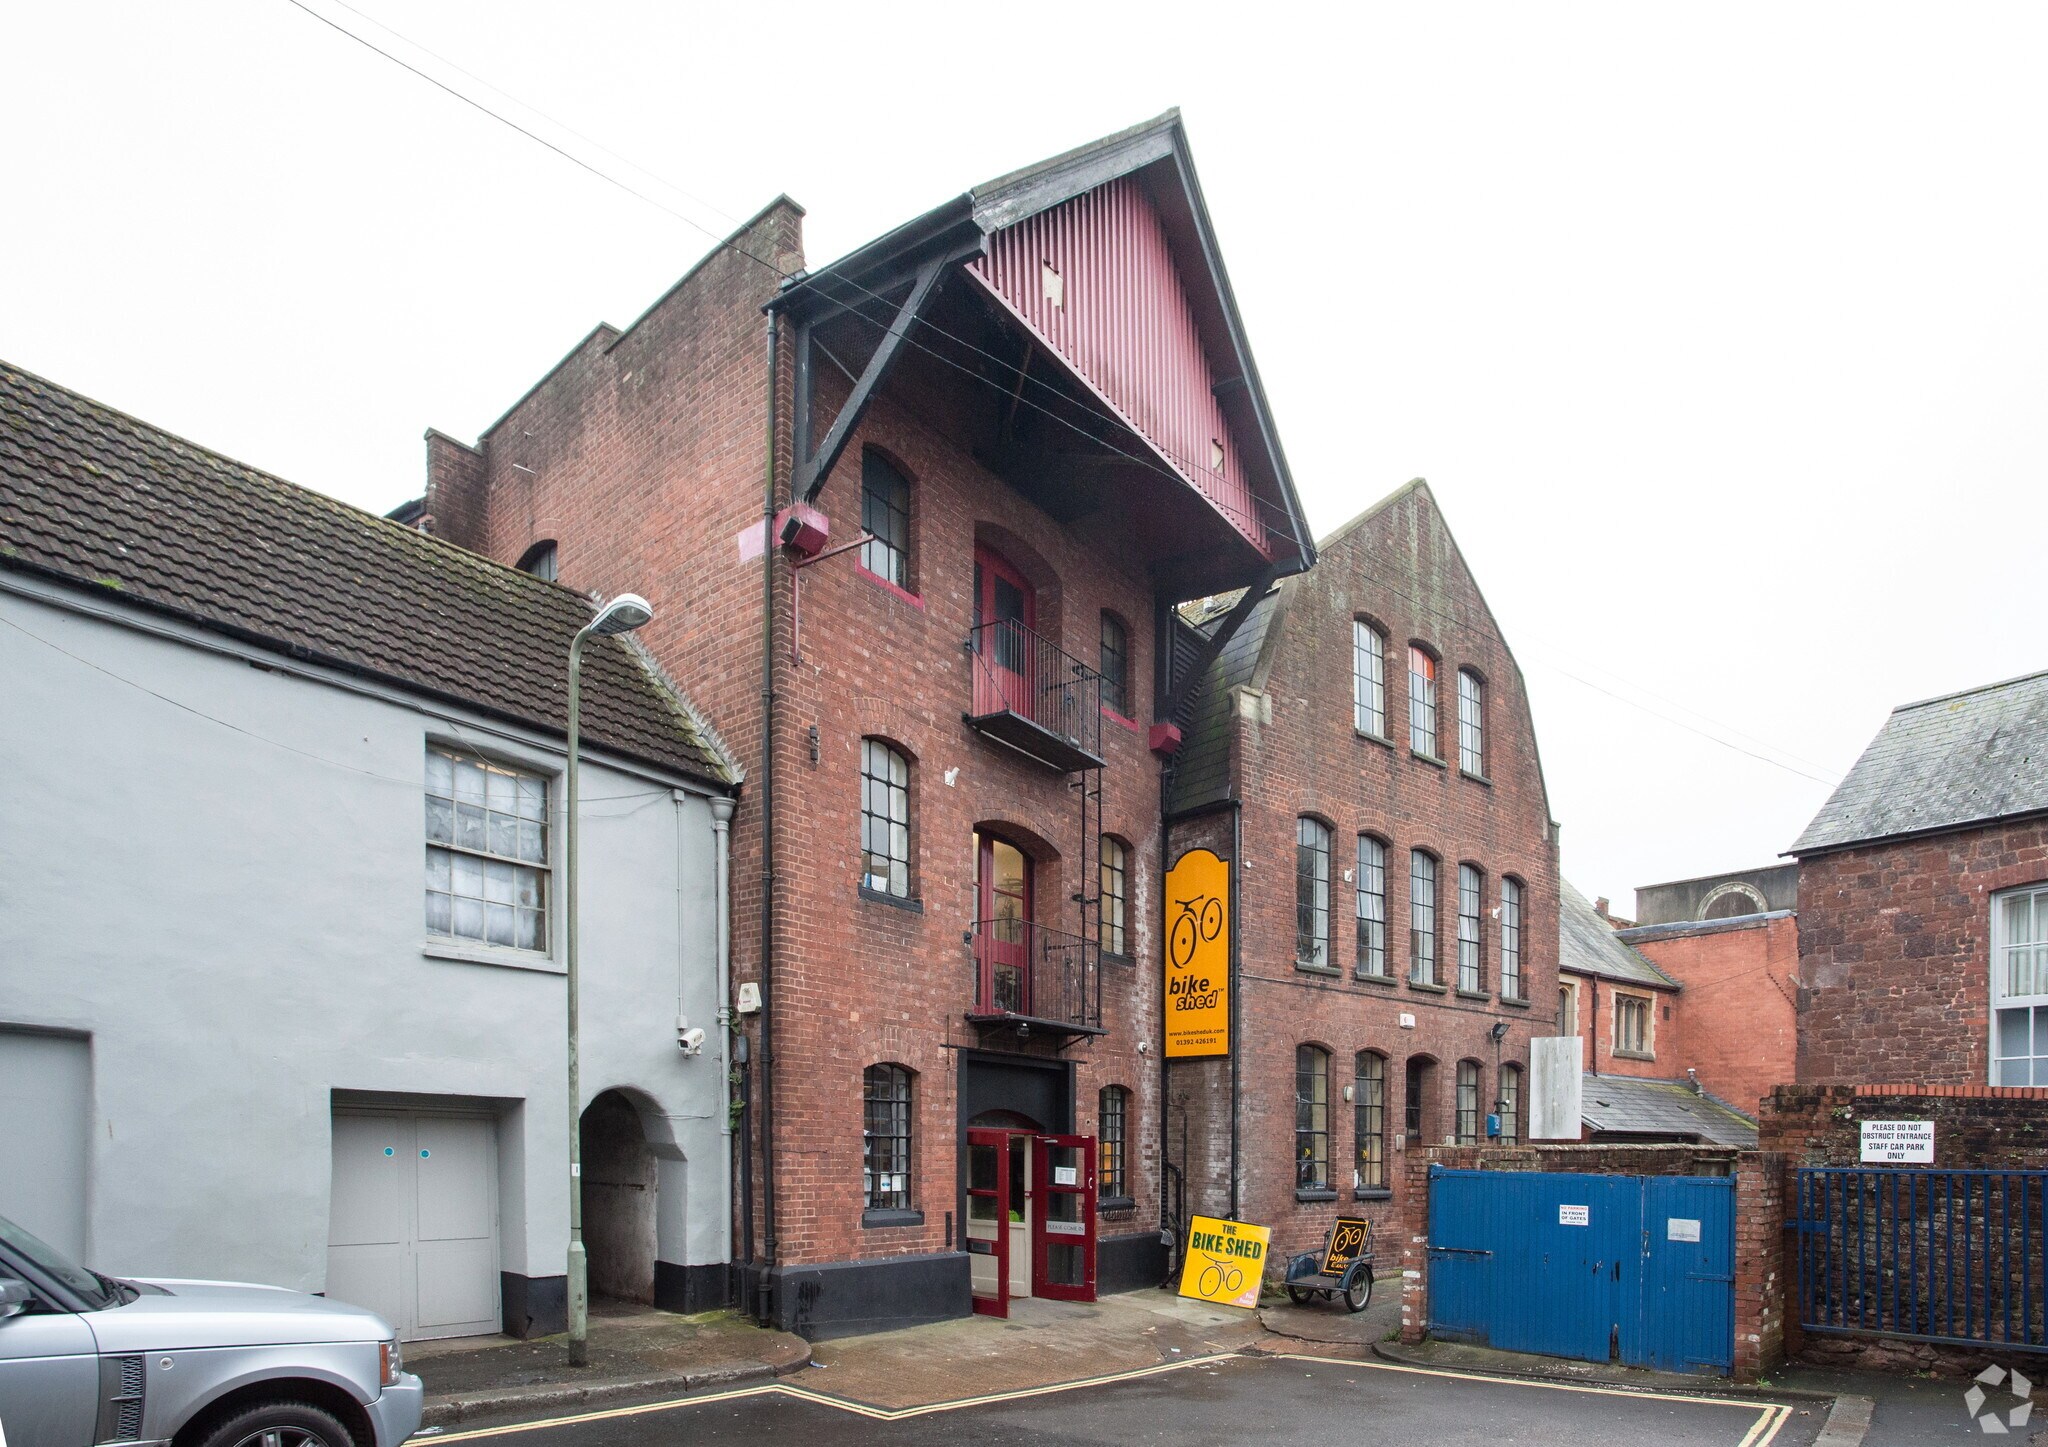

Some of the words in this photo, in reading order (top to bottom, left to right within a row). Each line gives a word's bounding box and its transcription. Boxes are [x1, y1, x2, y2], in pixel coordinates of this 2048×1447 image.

[1169, 974, 1210, 995] bike
[1176, 990, 1218, 1011] shed
[1168, 1028, 1225, 1036] www.bikesheduk.com
[1176, 1038, 1194, 1046] 01392
[1872, 1123, 1895, 1131] PLEASE
[1862, 1132, 1895, 1140] OBSTRUCT
[1896, 1132, 1932, 1140] ENTRANCE
[1868, 1142, 1888, 1150] STAFF
[1906, 1143, 1925, 1151] PARK
[1887, 1152, 1905, 1160] ONLY
[1222, 1224, 1237, 1236] THE
[1192, 1231, 1224, 1254] BIKE
[1225, 1237, 1262, 1260] SHED
[1330, 1253, 1349, 1262] bike
